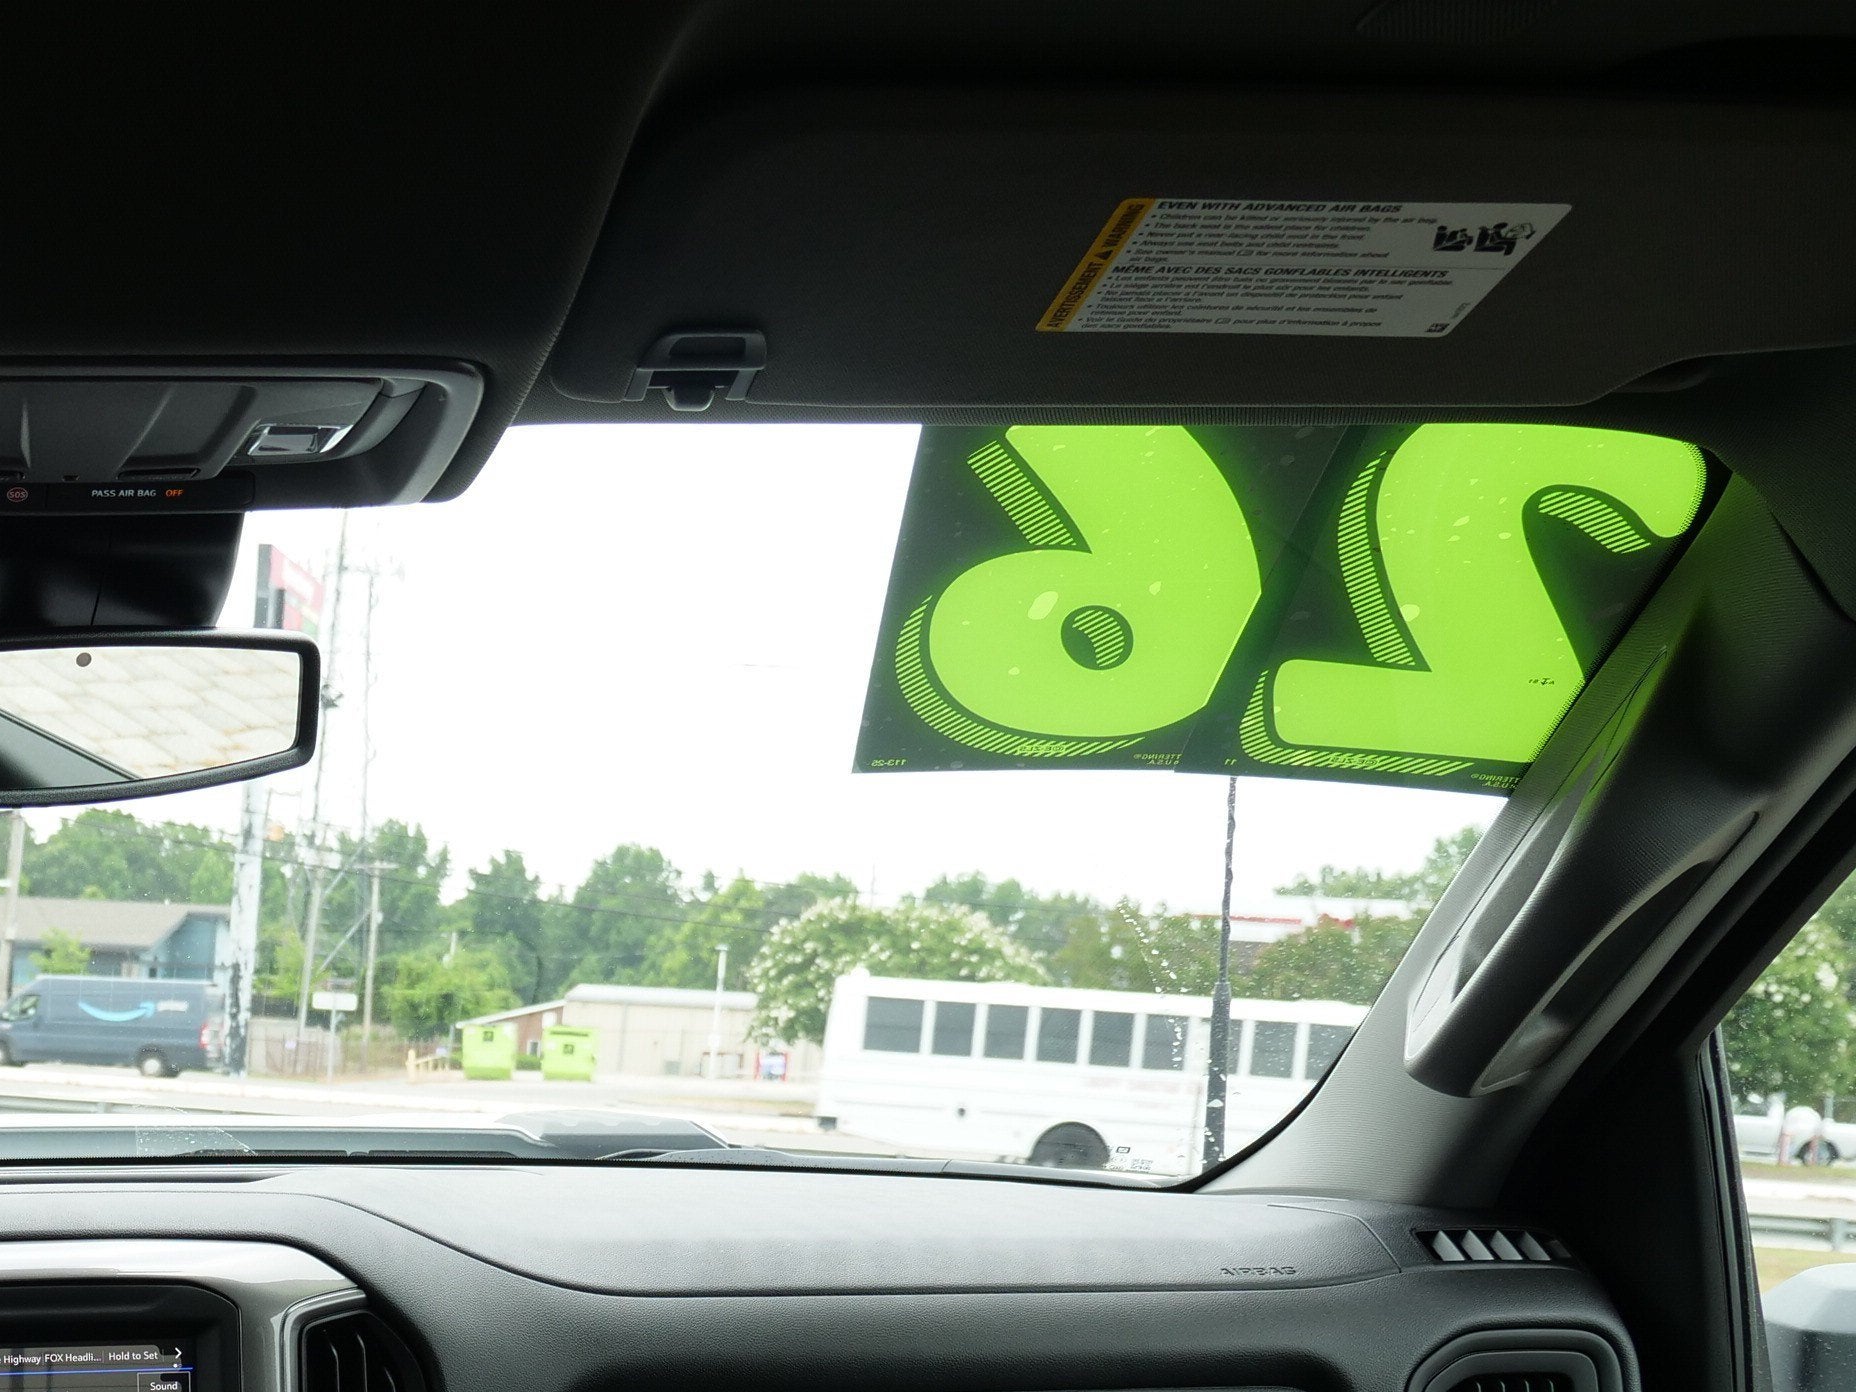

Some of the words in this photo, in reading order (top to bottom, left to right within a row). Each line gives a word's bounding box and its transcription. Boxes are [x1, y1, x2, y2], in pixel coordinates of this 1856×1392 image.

[1158, 201, 1197, 210] EVEN
[1200, 202, 1241, 211] WITH
[1243, 203, 1327, 212] ADVANCED
[1331, 204, 1356, 212] AIR
[1360, 204, 1402, 213] BAGS
[1104, 203, 1145, 249] WARNING
[1155, 266, 1193, 275] AVEC
[1195, 267, 1223, 275] DES
[1225, 267, 1262, 276] SACS
[1264, 268, 1351, 277] GONFLABLES
[1354, 269, 1450, 278] INTELLIGENTS
[1046, 261, 1103, 329] AVERTISSEMENT
[8, 490, 28, 499] SOS
[92, 489, 116, 498] PASS
[118, 489, 134, 498] AIR
[136, 489, 156, 498] BAG
[165, 489, 184, 498] OFF
[1221, 1266, 1296, 1276] AIRBAG
[1, 1354, 41, 1367] Highway
[45, 1353, 64, 1363] FOX
[65, 1352, 102, 1362] Headli...
[108, 1351, 130, 1361] Hold
[131, 1352, 141, 1361] to
[143, 1350, 158, 1360] Set
[150, 1381, 178, 1391] Sound
